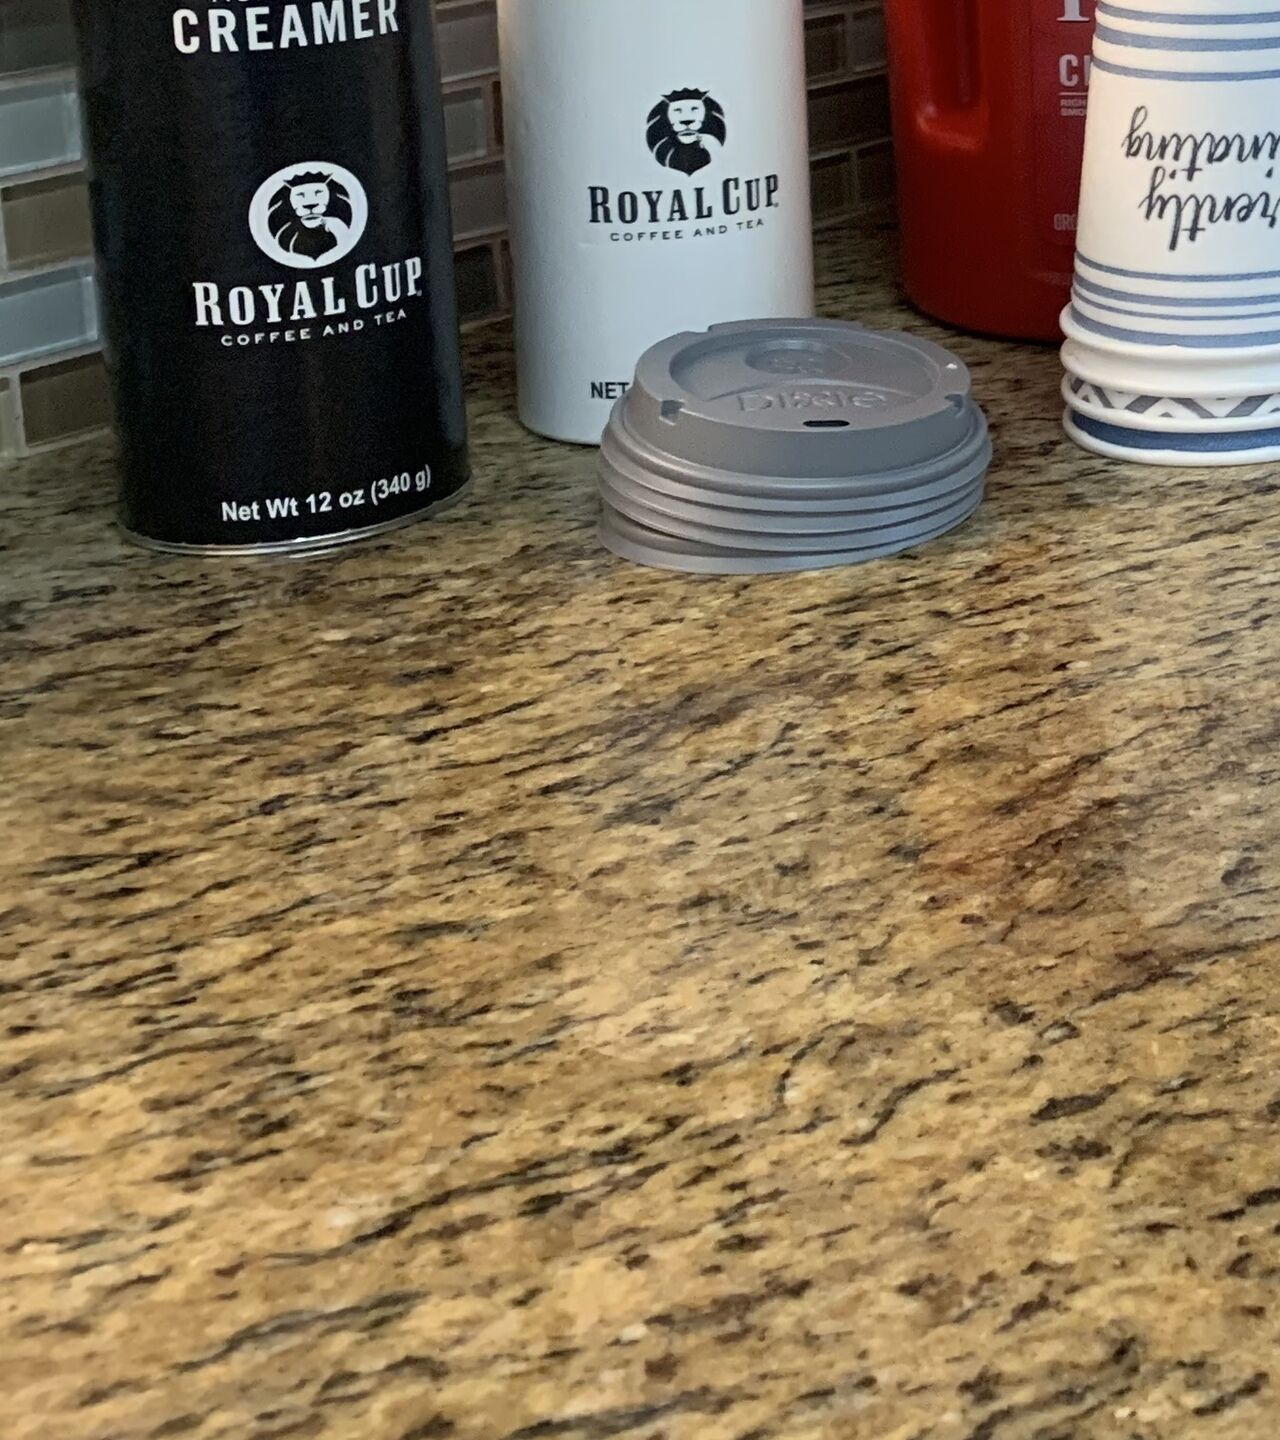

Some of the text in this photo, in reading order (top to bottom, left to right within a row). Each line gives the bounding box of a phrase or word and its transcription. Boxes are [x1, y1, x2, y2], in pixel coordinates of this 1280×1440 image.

[587, 174, 779, 225] ROYAL CUP
[610, 218, 764, 242] COFFEE AND TEA
[192, 256, 422, 326] ROYAL CUP
[221, 309, 407, 347] COFFEE AND TEA
[590, 381, 629, 399] NET
[221, 464, 432, 522] Net Wt 12 oz (340 g)
